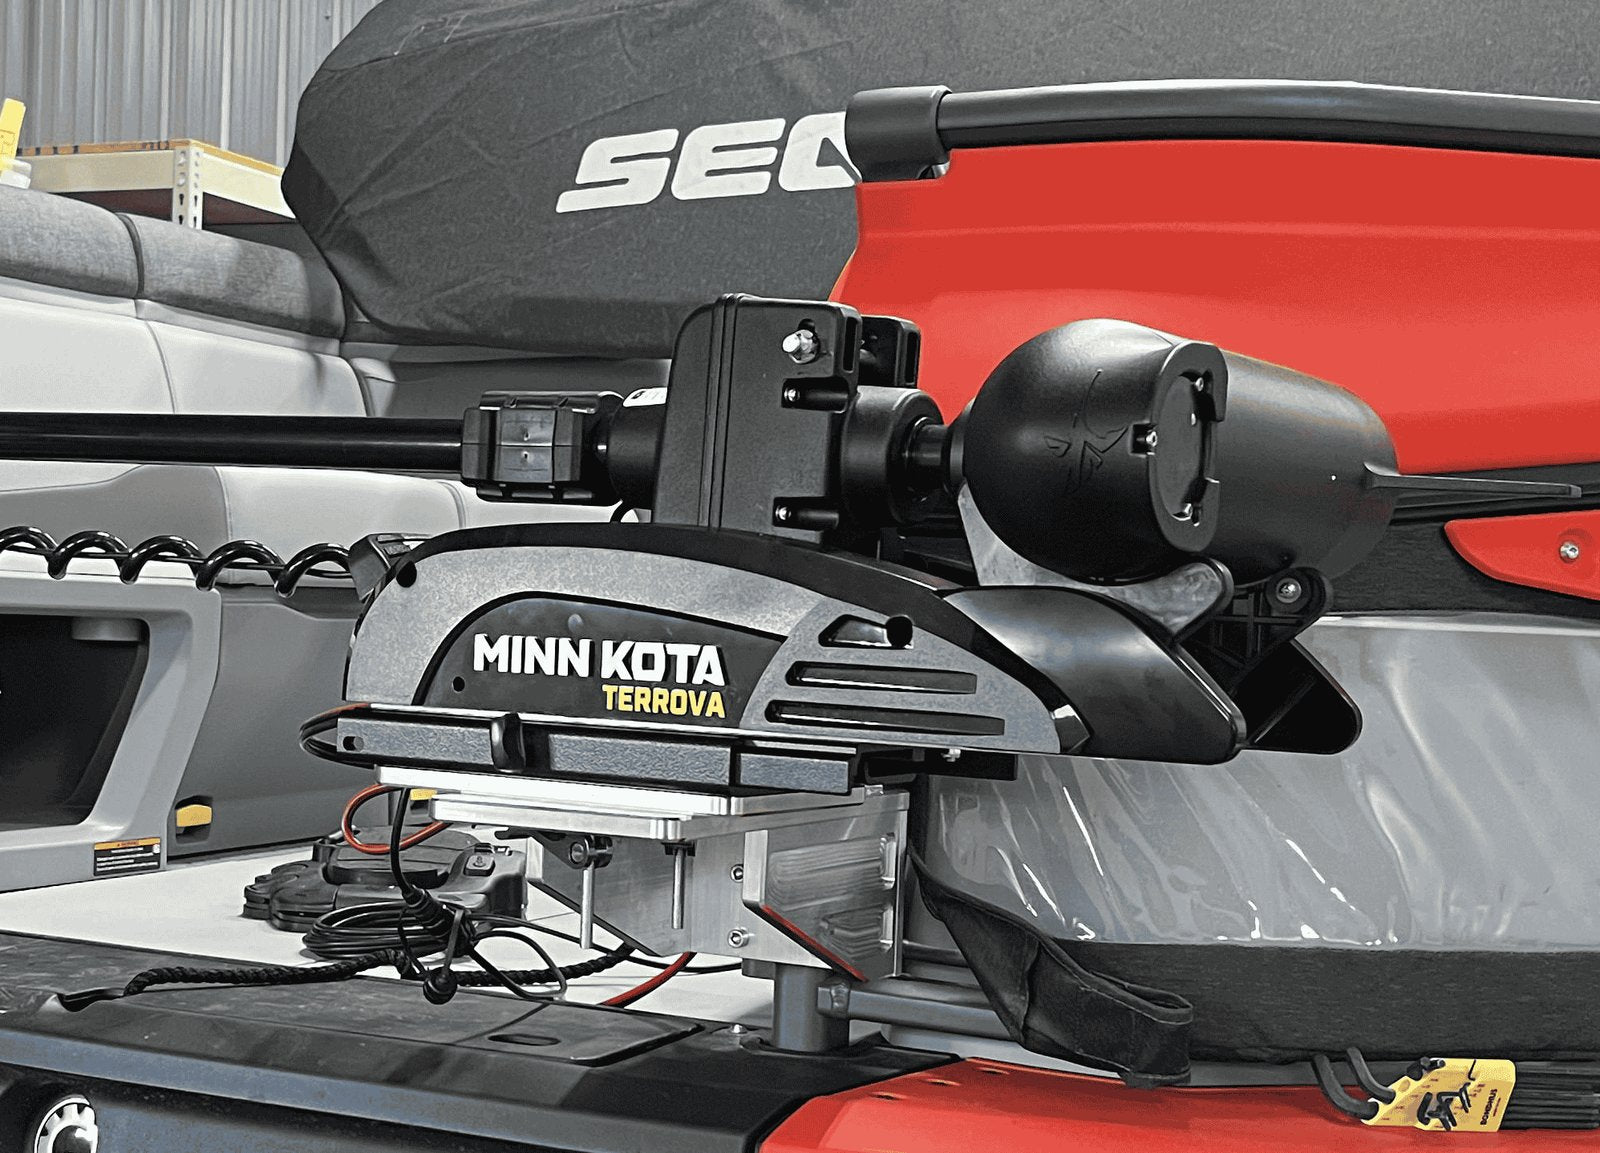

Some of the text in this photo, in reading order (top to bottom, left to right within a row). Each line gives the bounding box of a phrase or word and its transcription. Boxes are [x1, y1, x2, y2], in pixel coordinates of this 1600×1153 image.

[473, 633, 727, 687] MINN KOTA
[602, 684, 726, 718] TERROVA
